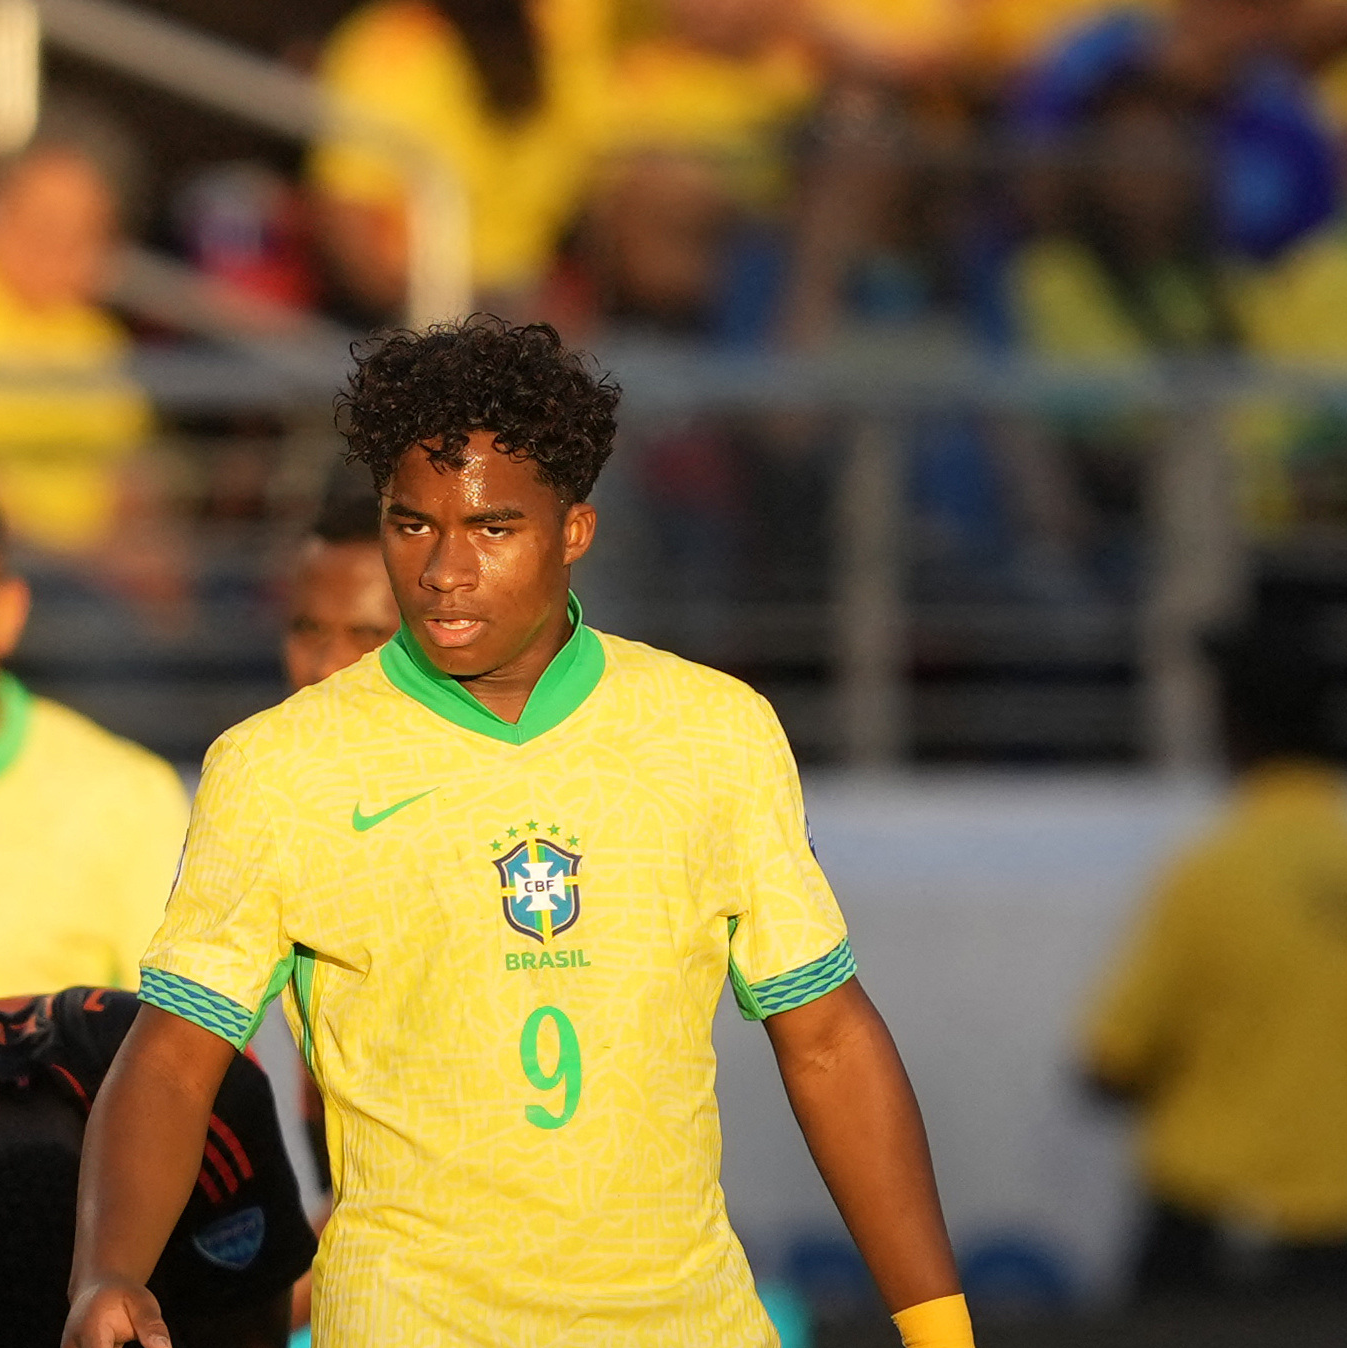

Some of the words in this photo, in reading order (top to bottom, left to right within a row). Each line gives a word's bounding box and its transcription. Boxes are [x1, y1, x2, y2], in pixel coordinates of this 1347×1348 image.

[524, 879, 555, 893] CBF
[506, 949, 591, 971] BRASIL
[519, 1005, 582, 1130] 9
